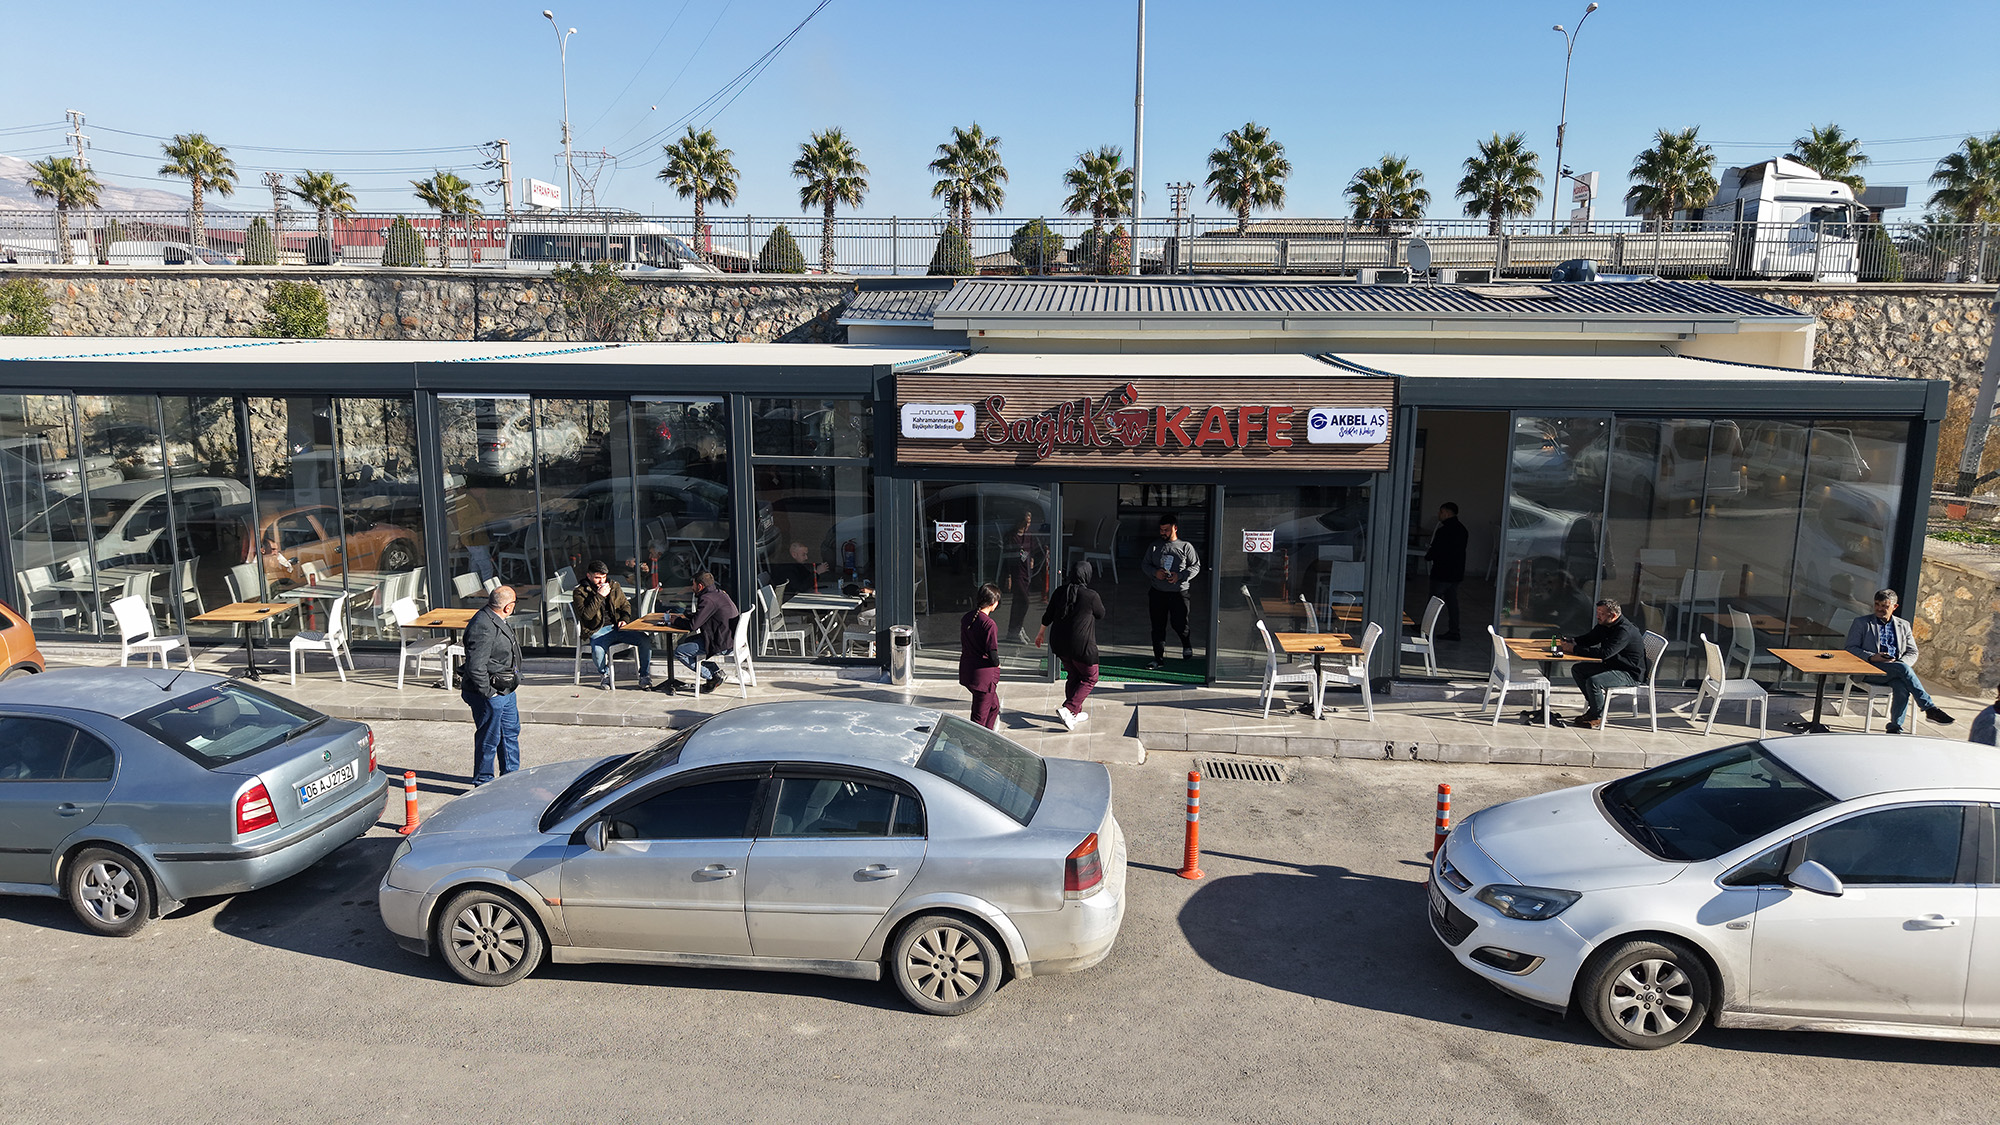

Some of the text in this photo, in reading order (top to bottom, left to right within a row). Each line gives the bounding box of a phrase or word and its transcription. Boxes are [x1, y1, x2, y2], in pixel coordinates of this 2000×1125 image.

[1154, 405, 1295, 448] KAFE
[1330, 414, 1385, 428] AKBEL AŞ
[306, 783, 319, 798] 06
